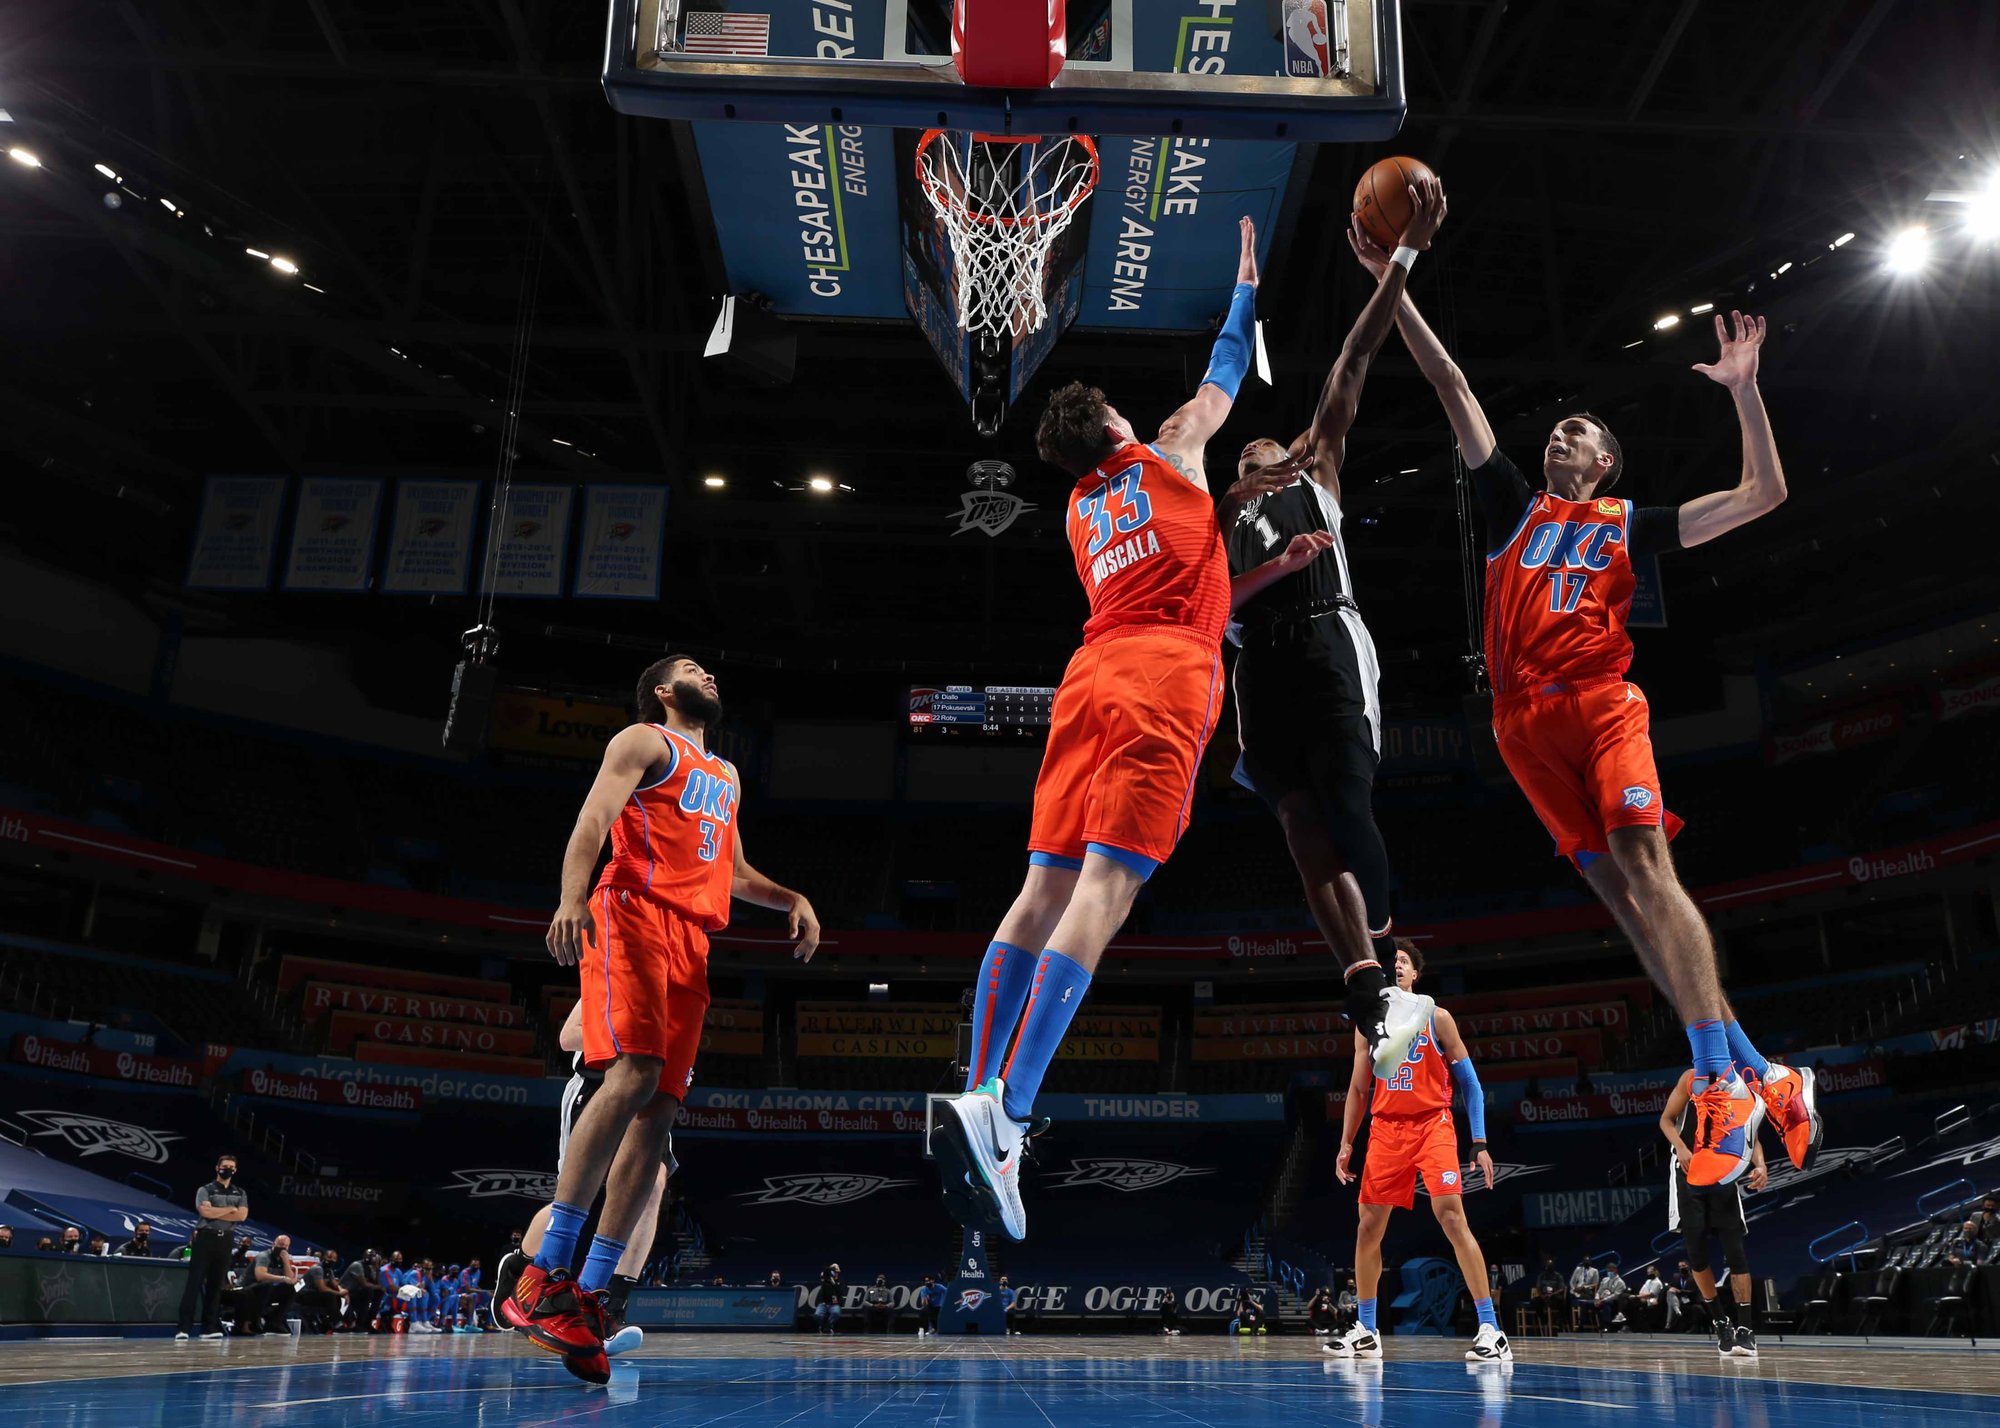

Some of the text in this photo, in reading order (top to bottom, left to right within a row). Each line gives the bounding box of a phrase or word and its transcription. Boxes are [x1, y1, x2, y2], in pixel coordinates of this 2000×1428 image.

[1291, 59, 1314, 75] NBA
[838, 125, 868, 197] ENERG
[784, 123, 841, 297] CHESAPEAK
[1107, 136, 1156, 311] NERGY ARENA
[1076, 461, 1153, 557] 33
[1255, 513, 1282, 551] 1
[1520, 520, 1623, 571] OKC
[1091, 530, 1161, 587] MUSCALA
[1547, 571, 1588, 613] 17
[941, 726, 948, 734] 3
[1841, 714, 1893, 739] PATIO
[1412, 726, 1463, 760] CITY
[679, 768, 736, 826] OKC
[1872, 850, 1936, 880] Health
[1245, 938, 1297, 957] Health
[313, 987, 514, 1026] RIVERWIND
[374, 1020, 496, 1050] CASINO
[808, 1015, 954, 1033] RIVERWIND
[1222, 1012, 1350, 1035] RIVERWIN
[134, 1033, 156, 1047] 118
[207, 1044, 228, 1057] 119
[832, 1038, 929, 1055] CASINO
[1242, 1038, 1339, 1056] CASINO
[41, 1046, 91, 1072] Health
[137, 1063, 193, 1086] Health
[1834, 1066, 1880, 1091] Health
[1386, 1067, 1414, 1091] 22
[268, 1080, 318, 1101] Health
[362, 1087, 415, 1109] Health
[707, 1092, 915, 1111] OKLAHOMA CITY
[1265, 1093, 1284, 1103] 101
[692, 1109, 736, 1129] Health
[763, 1112, 808, 1131] Health
[835, 1112, 879, 1131] Health
[1084, 1099, 1200, 1118] THUNDER
[1538, 1100, 1589, 1120] Health
[279, 1174, 384, 1201] Budweiser
[961, 1269, 985, 1279] Health
[40, 1277, 74, 1303] Sprite
